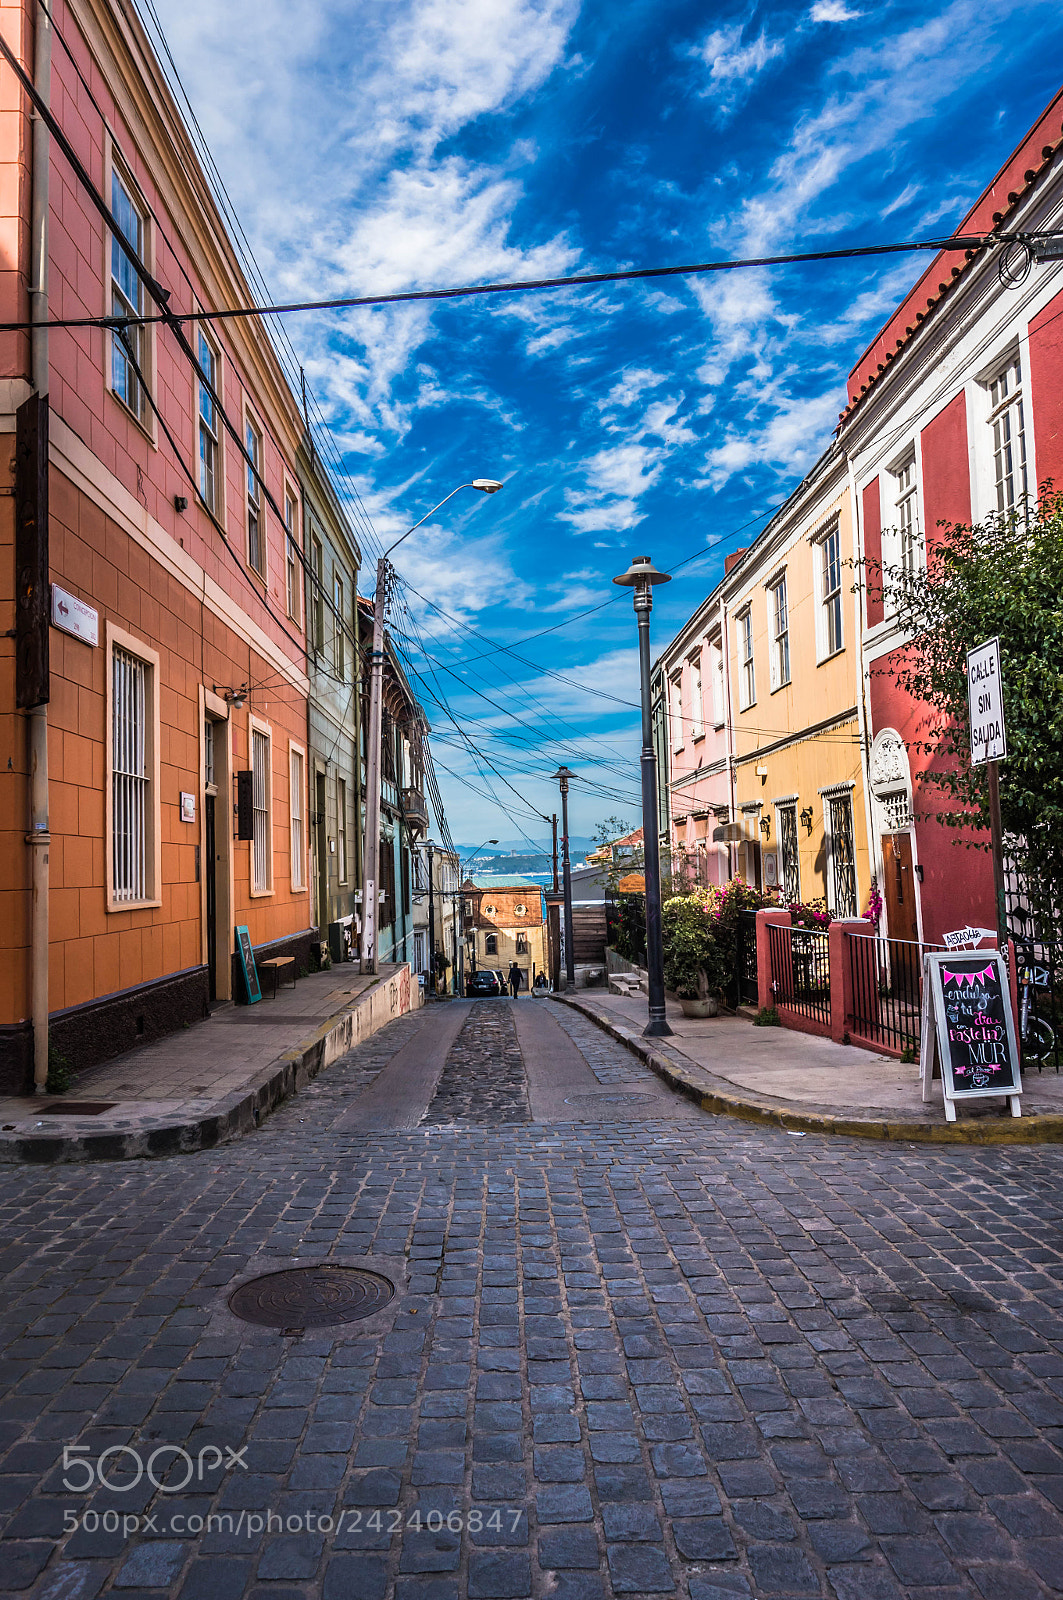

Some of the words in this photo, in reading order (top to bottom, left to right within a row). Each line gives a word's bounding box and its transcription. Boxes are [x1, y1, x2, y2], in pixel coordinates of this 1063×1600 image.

[970, 655, 995, 685] CALLE
[978, 692, 991, 714] SIN
[973, 721, 1001, 747] SALIDA
[968, 1040, 1007, 1065] MÜR
